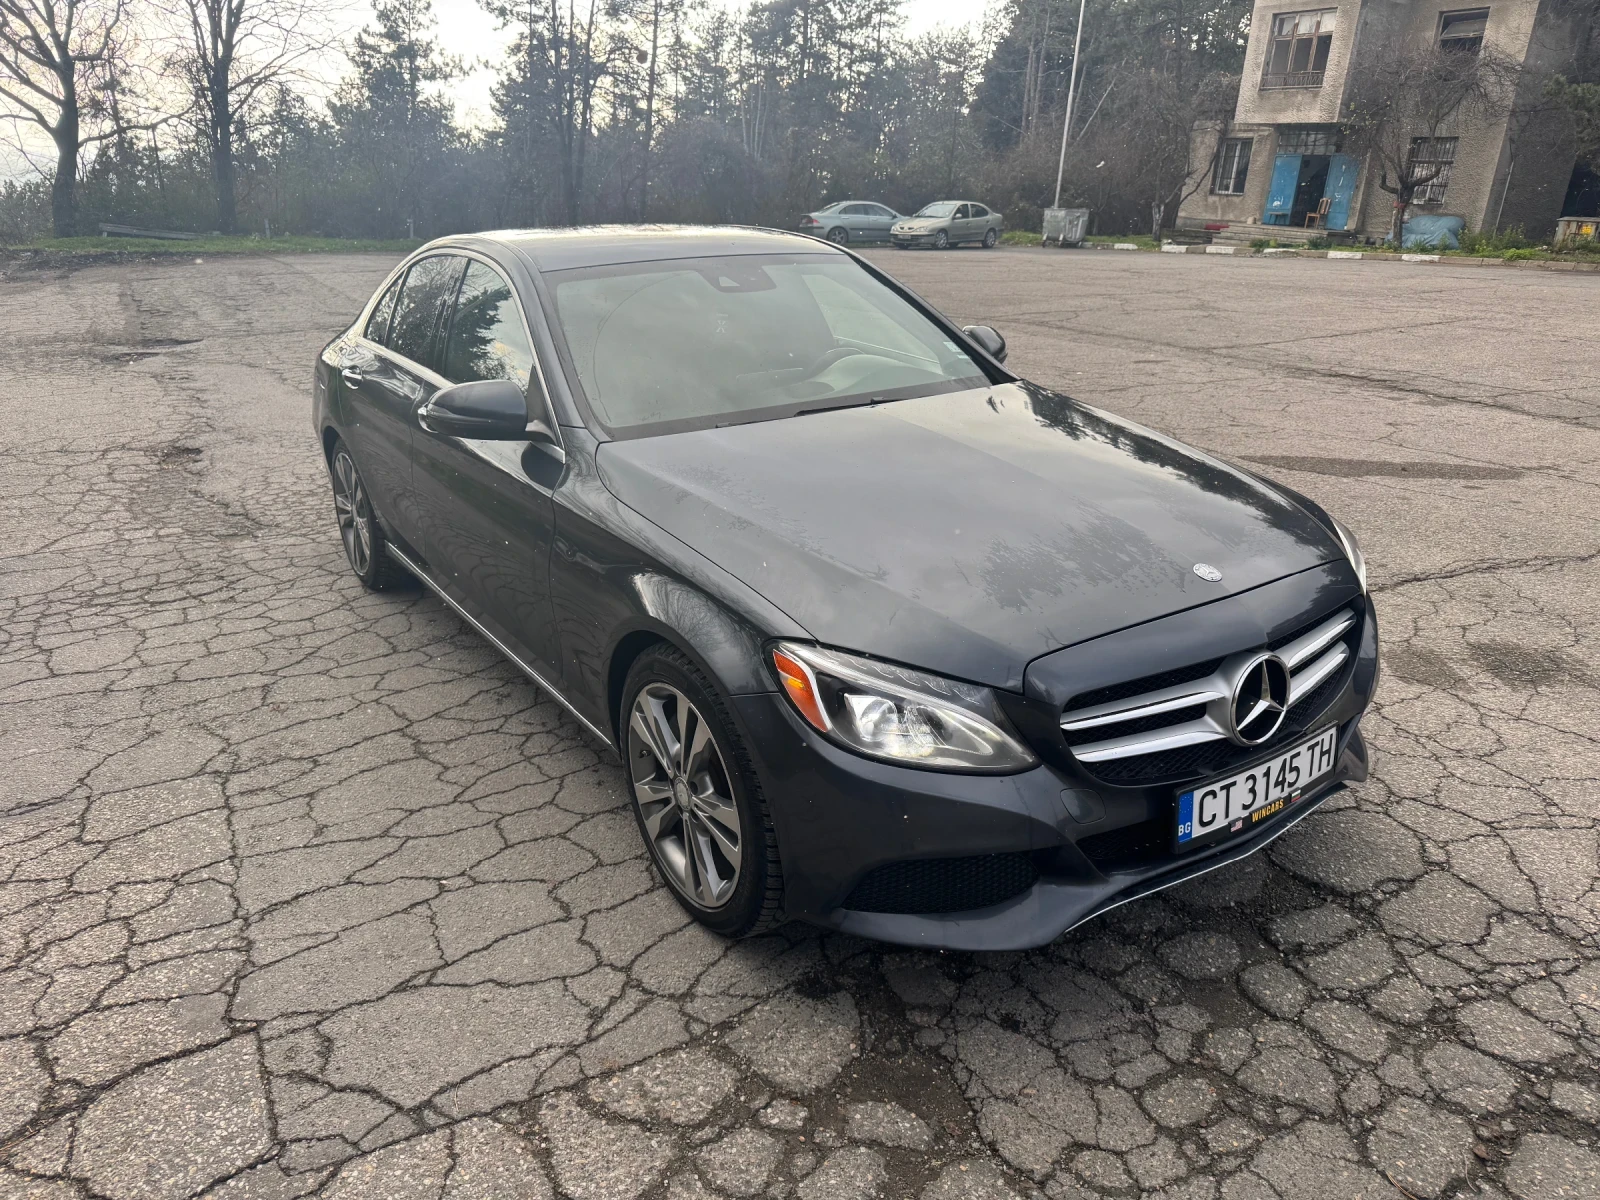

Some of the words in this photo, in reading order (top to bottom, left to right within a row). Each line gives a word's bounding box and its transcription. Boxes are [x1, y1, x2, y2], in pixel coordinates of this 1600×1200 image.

[1198, 781, 1237, 828] CT
[1242, 751, 1301, 811] 3145
[1306, 733, 1334, 778] TH
[1252, 799, 1284, 822] WINCARS
[1178, 822, 1191, 836] BG
